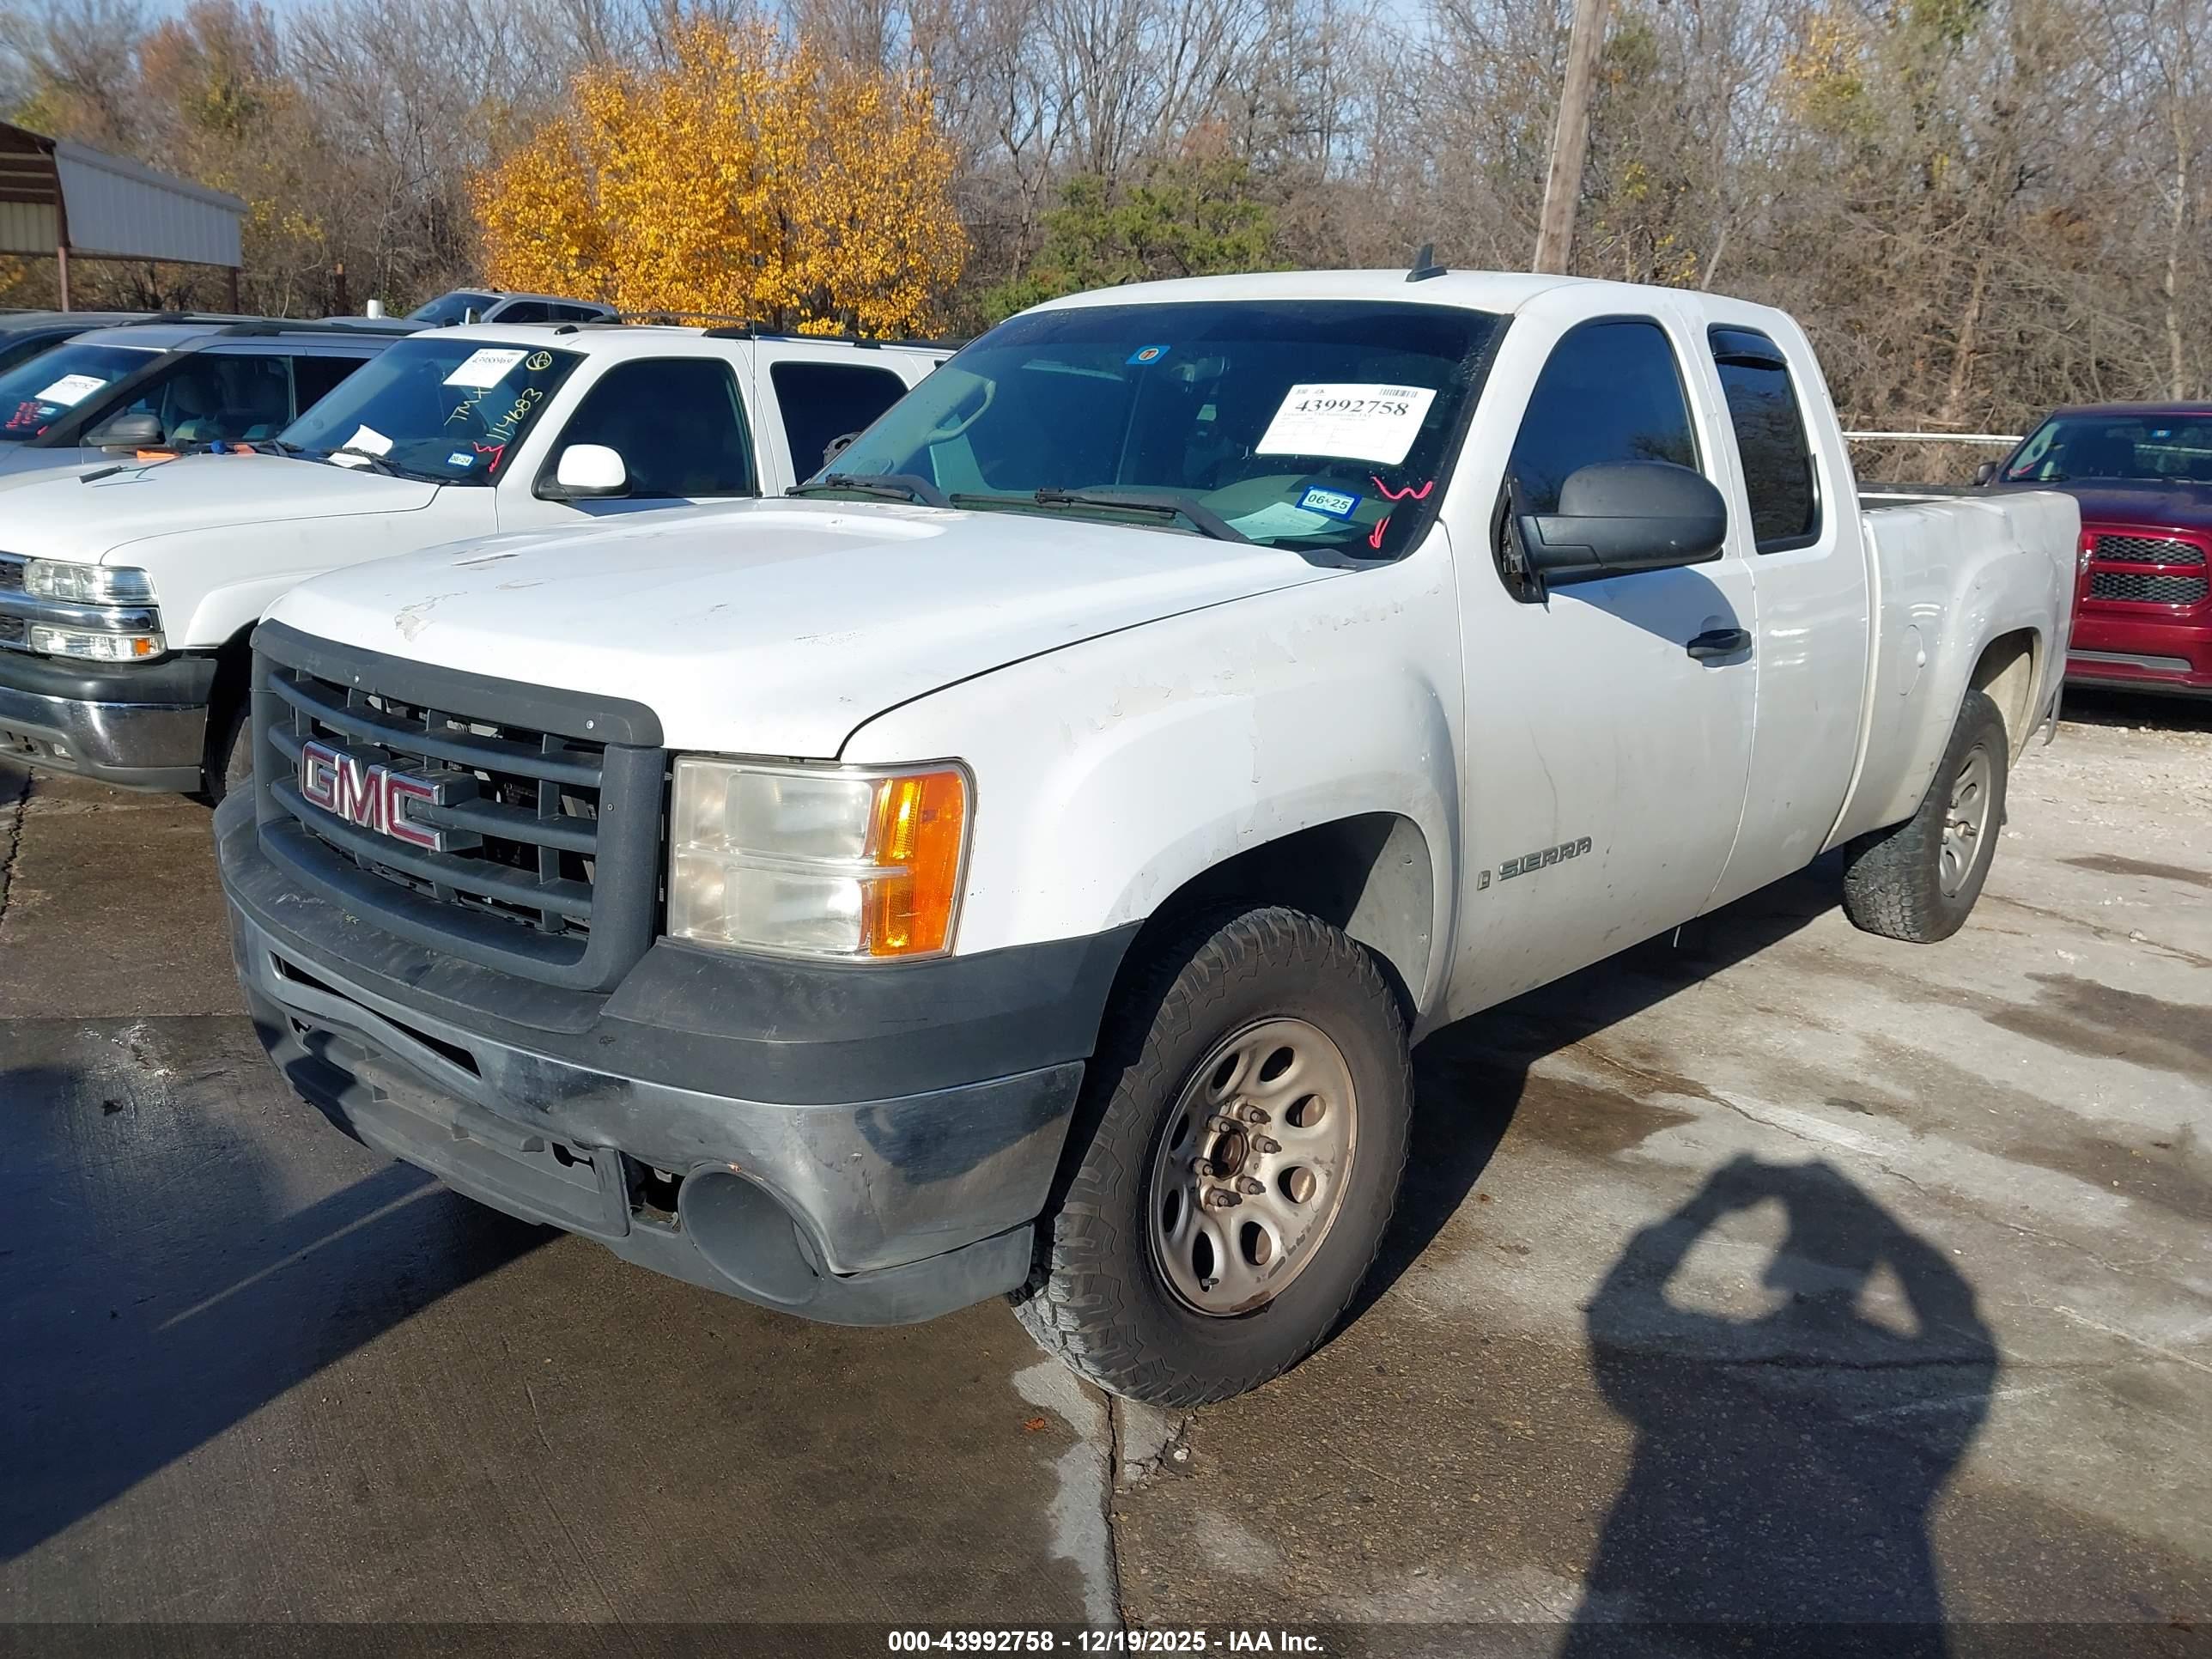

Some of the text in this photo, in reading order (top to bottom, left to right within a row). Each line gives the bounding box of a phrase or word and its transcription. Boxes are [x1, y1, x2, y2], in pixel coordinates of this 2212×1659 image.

[485, 387, 544, 442] 114683
[1295, 399, 1409, 416] 43992758
[301, 740, 443, 853] GMC
[1498, 836, 1593, 882] SIERRA
